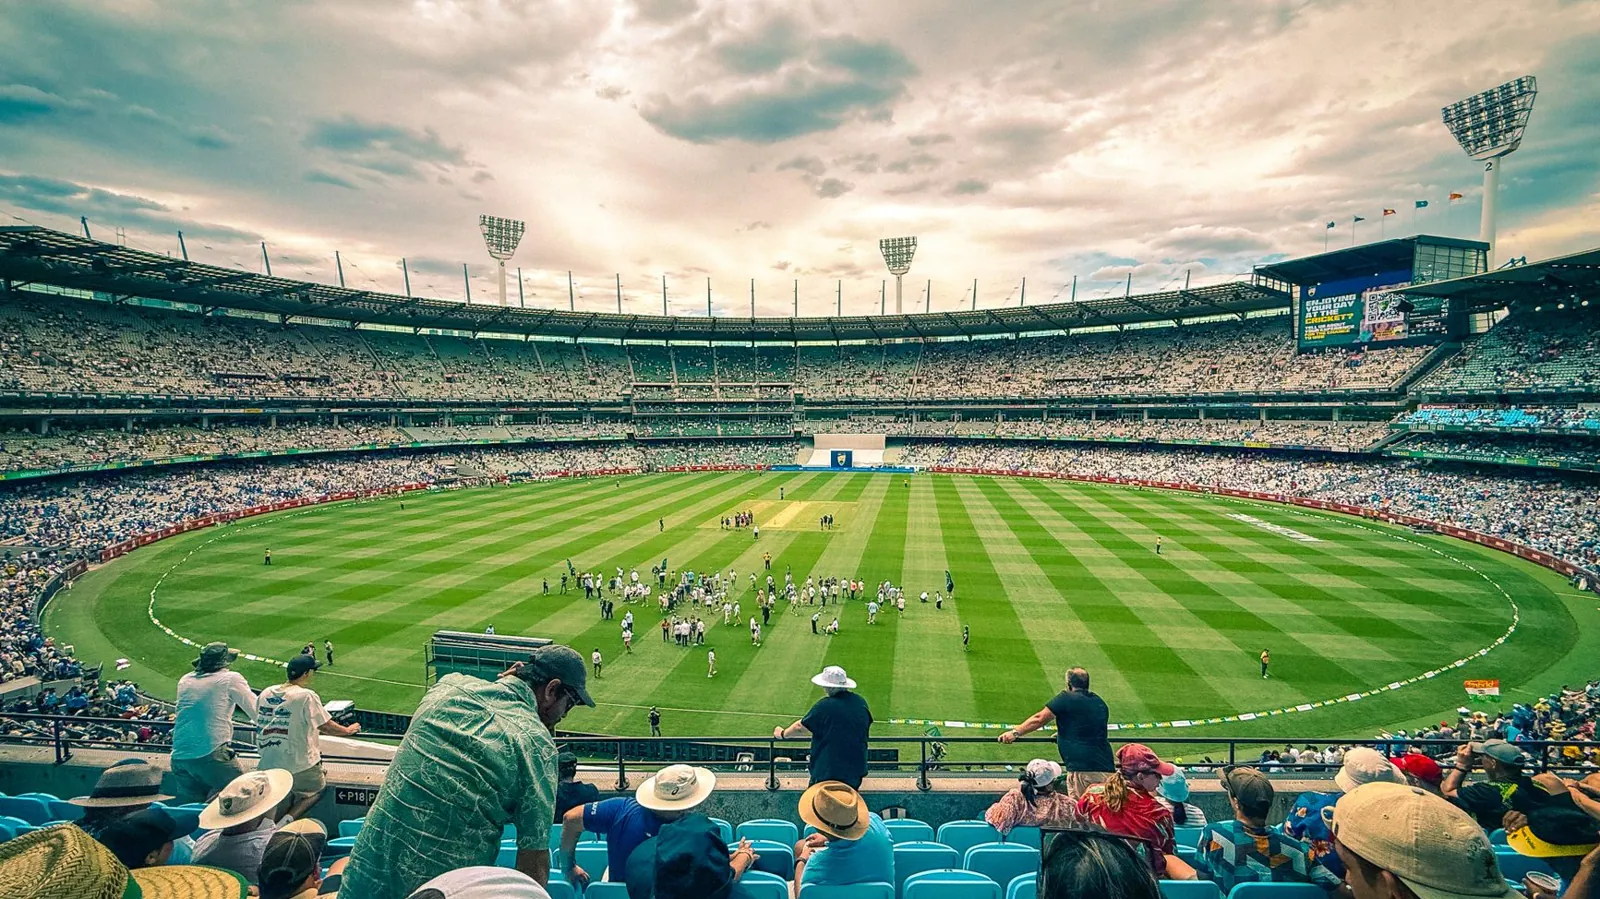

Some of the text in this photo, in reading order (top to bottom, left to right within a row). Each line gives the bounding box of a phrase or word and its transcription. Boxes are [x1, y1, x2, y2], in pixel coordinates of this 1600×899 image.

[1485, 162, 1493, 171] 2
[1306, 294, 1356, 306] ENJOYING
[1306, 301, 1354, 312] YOUR DAY
[1305, 313, 1354, 324] CRICKET?
[347, 791, 365, 802] P18
